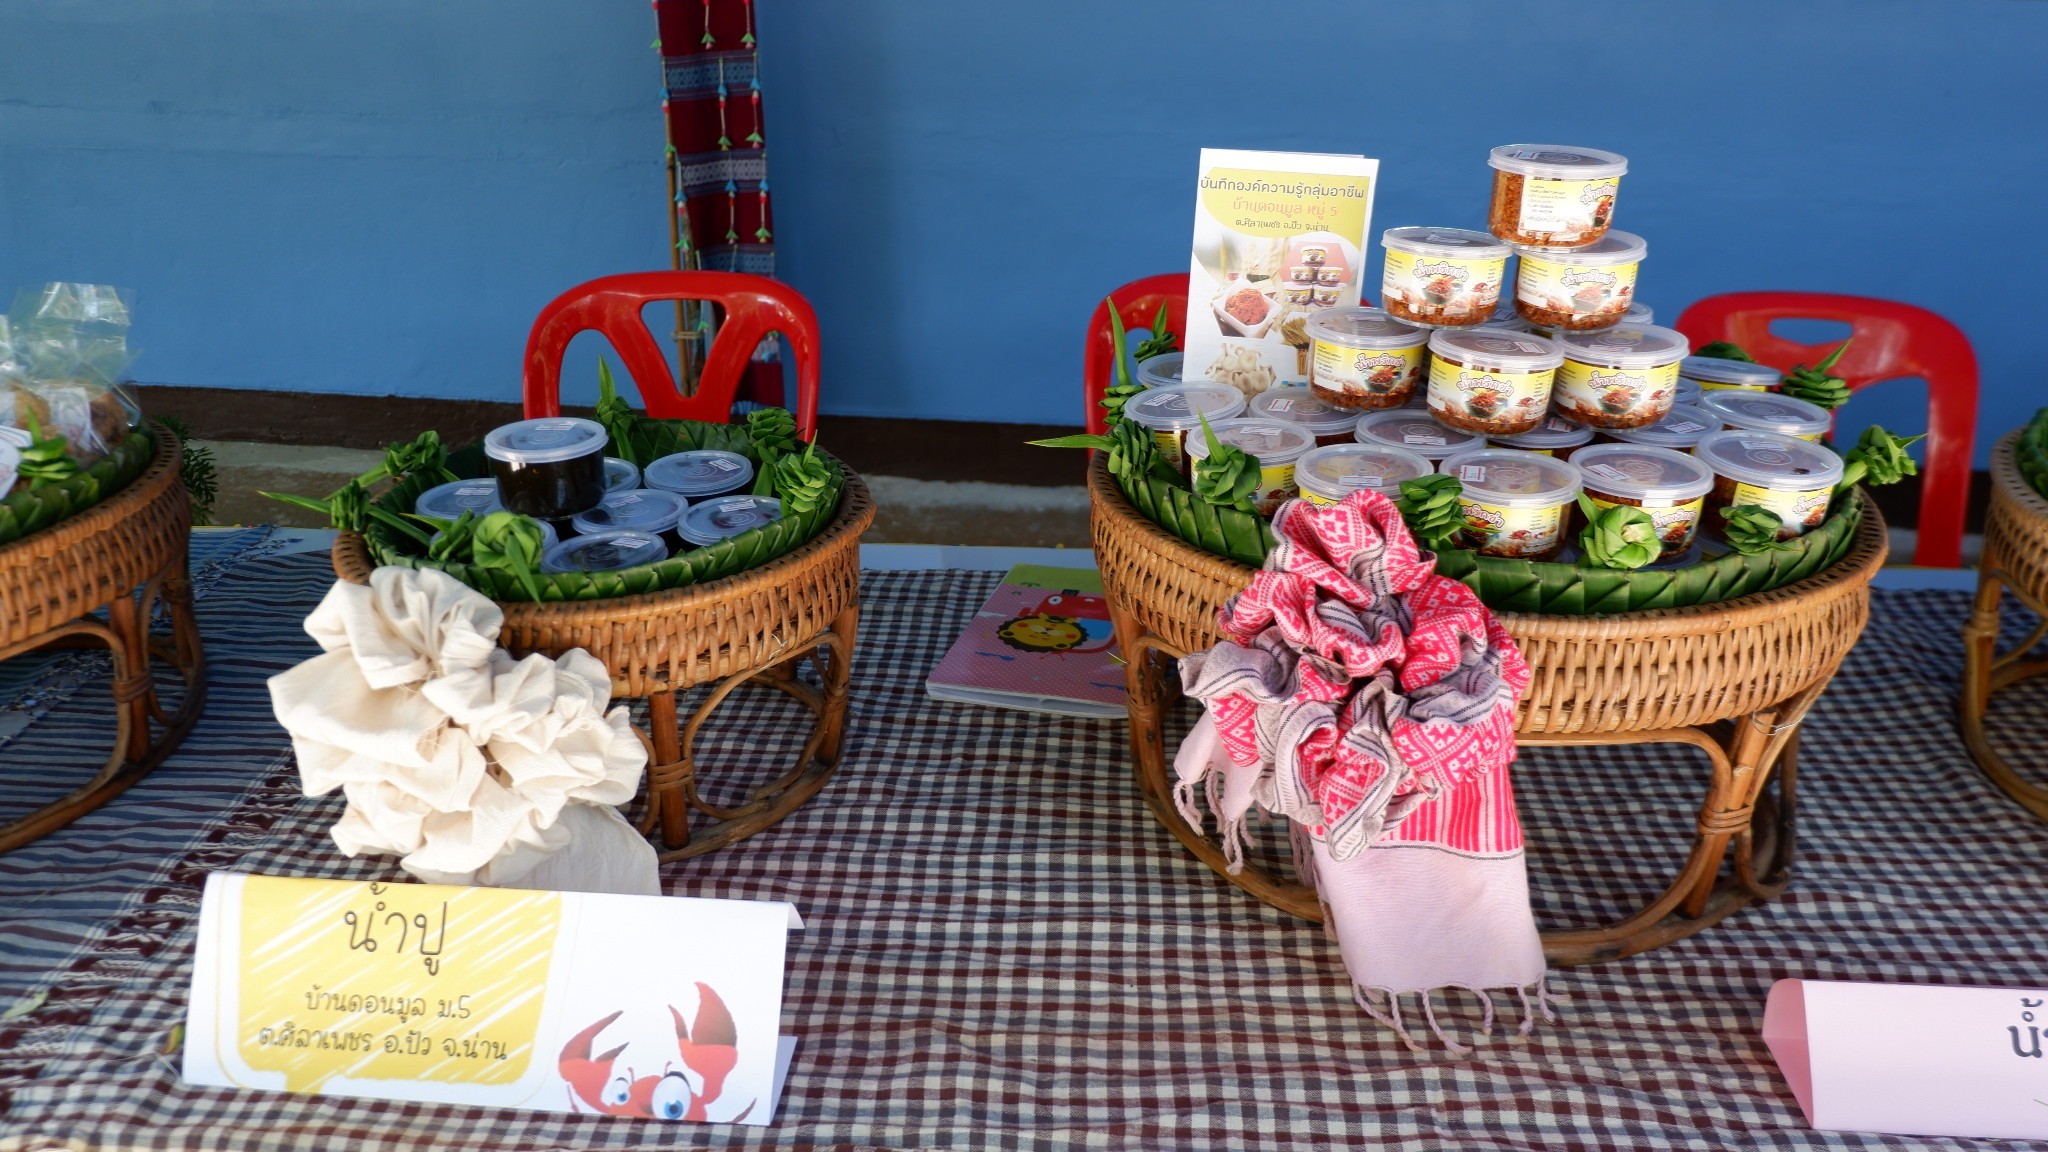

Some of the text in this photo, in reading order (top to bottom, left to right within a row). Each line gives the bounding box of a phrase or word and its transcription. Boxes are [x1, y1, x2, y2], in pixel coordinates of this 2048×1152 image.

[1233, 197, 1338, 220] บ้านดอนมูล หมู่ 5
[345, 882, 447, 976] น้ำปู
[305, 984, 472, 1024] บ้านดอนมูล ม.5
[258, 1021, 508, 1061] ต.ศิลาเพชร อ.ปัว จ.น่าน
